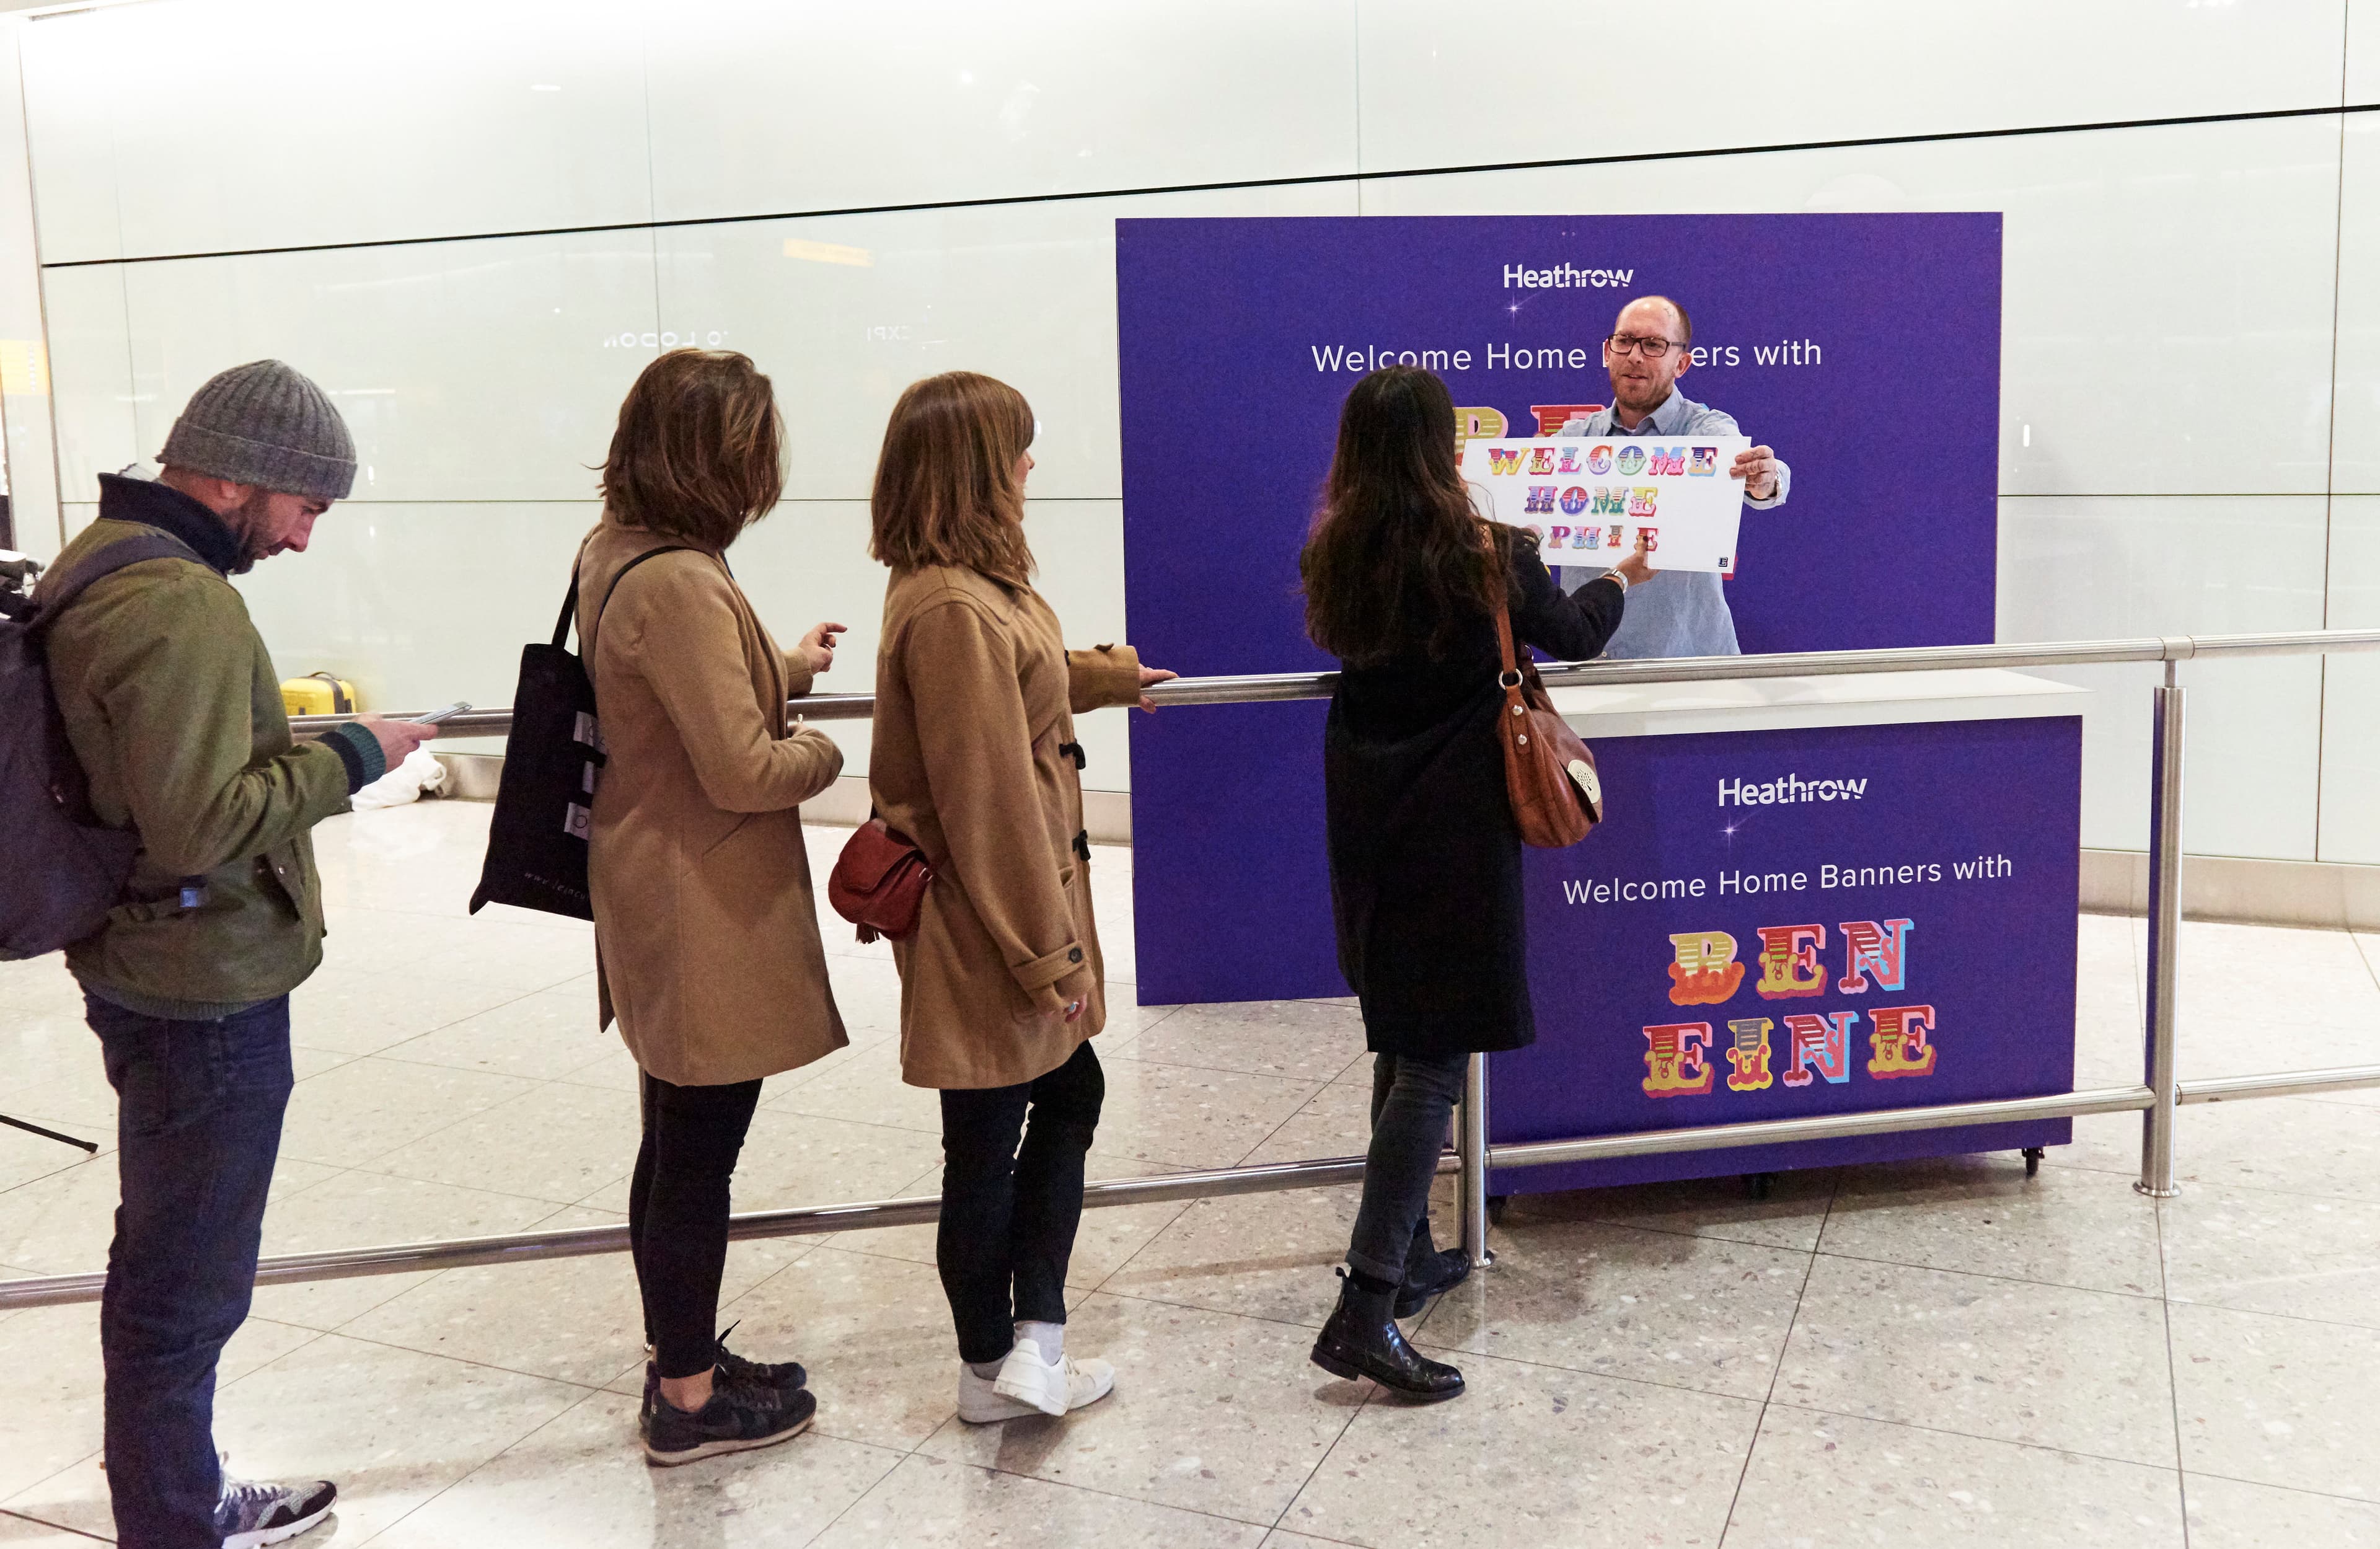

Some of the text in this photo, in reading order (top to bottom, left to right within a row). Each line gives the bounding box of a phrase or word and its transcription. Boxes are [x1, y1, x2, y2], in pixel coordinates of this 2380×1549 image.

[1504, 262, 1634, 288] Heathrow
[1311, 345, 1471, 372] Welcome
[1488, 343, 1587, 369] Home
[1753, 338, 1822, 366] with
[1488, 444, 1719, 477] WELCOME
[1524, 486, 1659, 518] HOME
[1523, 524, 1659, 552] PHIE
[1719, 773, 1868, 806] Heathrow
[1562, 854, 2012, 904] Welcome Home Banners with
[1668, 917, 1915, 1006] BEN
[1642, 1004, 1937, 1098] EINE
